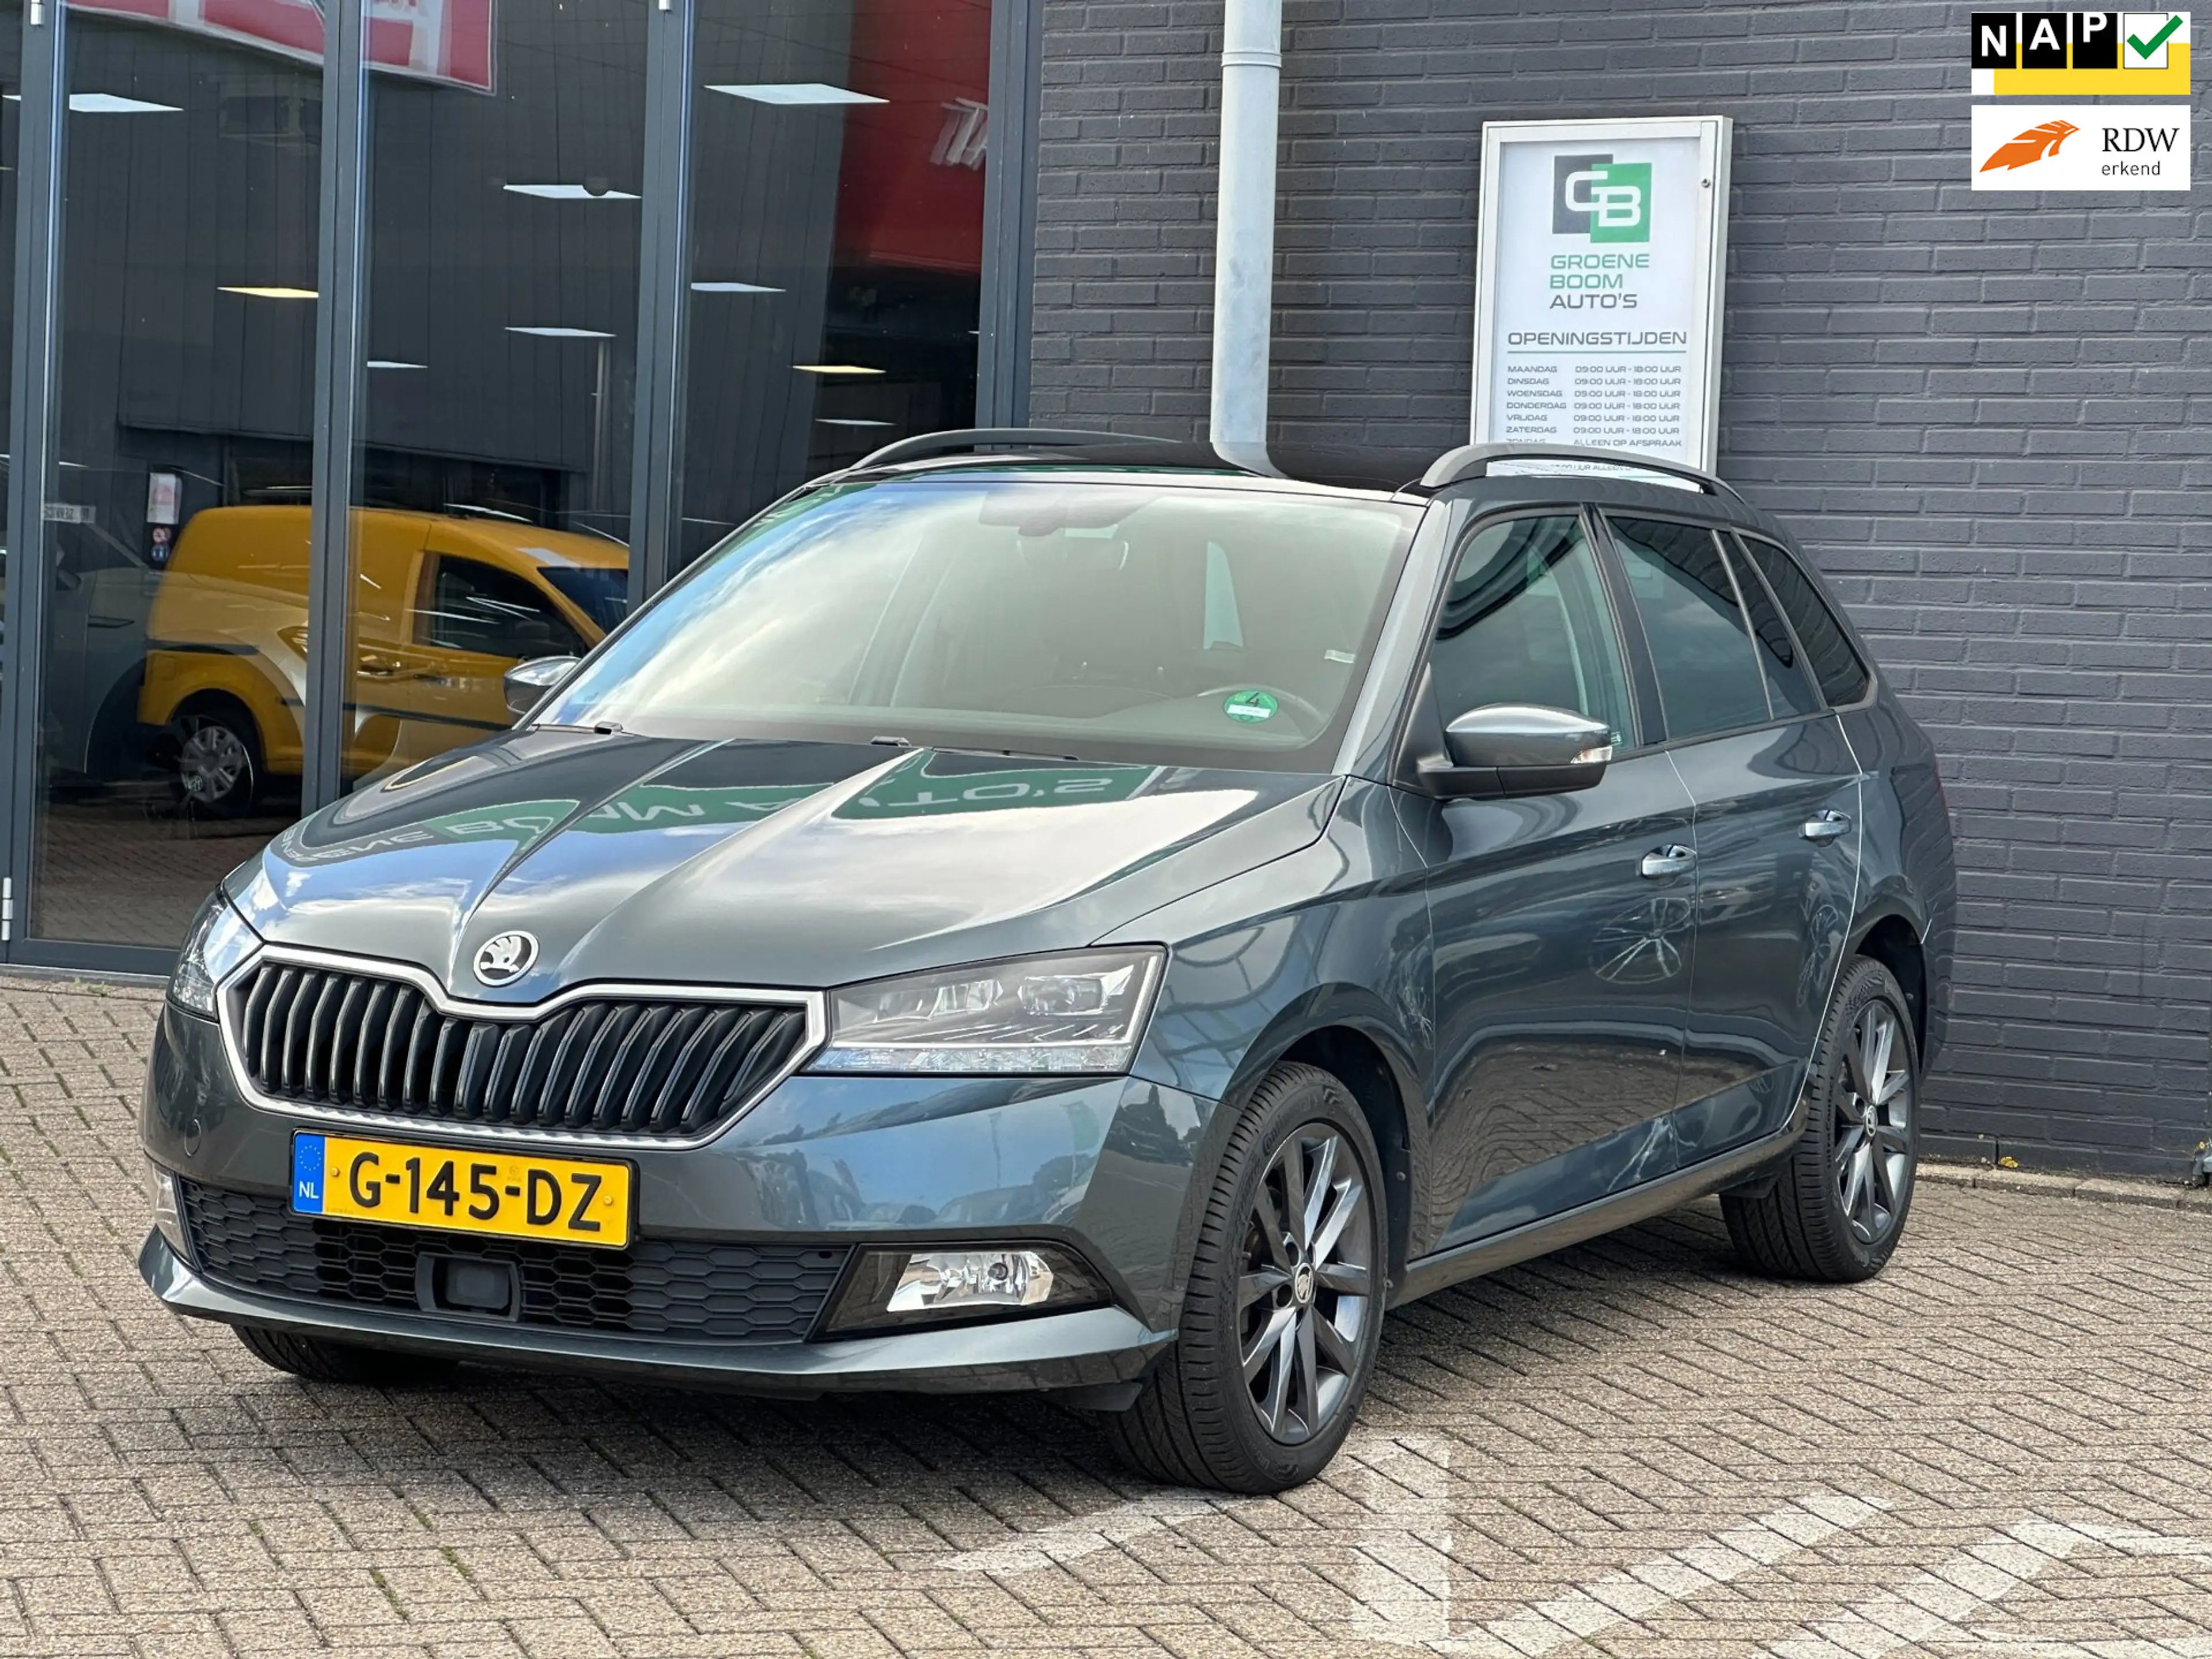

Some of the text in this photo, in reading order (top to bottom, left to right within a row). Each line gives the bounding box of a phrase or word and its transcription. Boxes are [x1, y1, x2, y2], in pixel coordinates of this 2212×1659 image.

[1551, 253, 1650, 269] GROENE
[1550, 274, 1623, 289] BOOM
[1550, 293, 1637, 309] AUTO'S
[1508, 332, 1687, 345] OPENINGSTIJDEN
[1245, 692, 1260, 707] 4
[298, 1181, 320, 1199] NL
[349, 1152, 602, 1232] G-145-DZ
